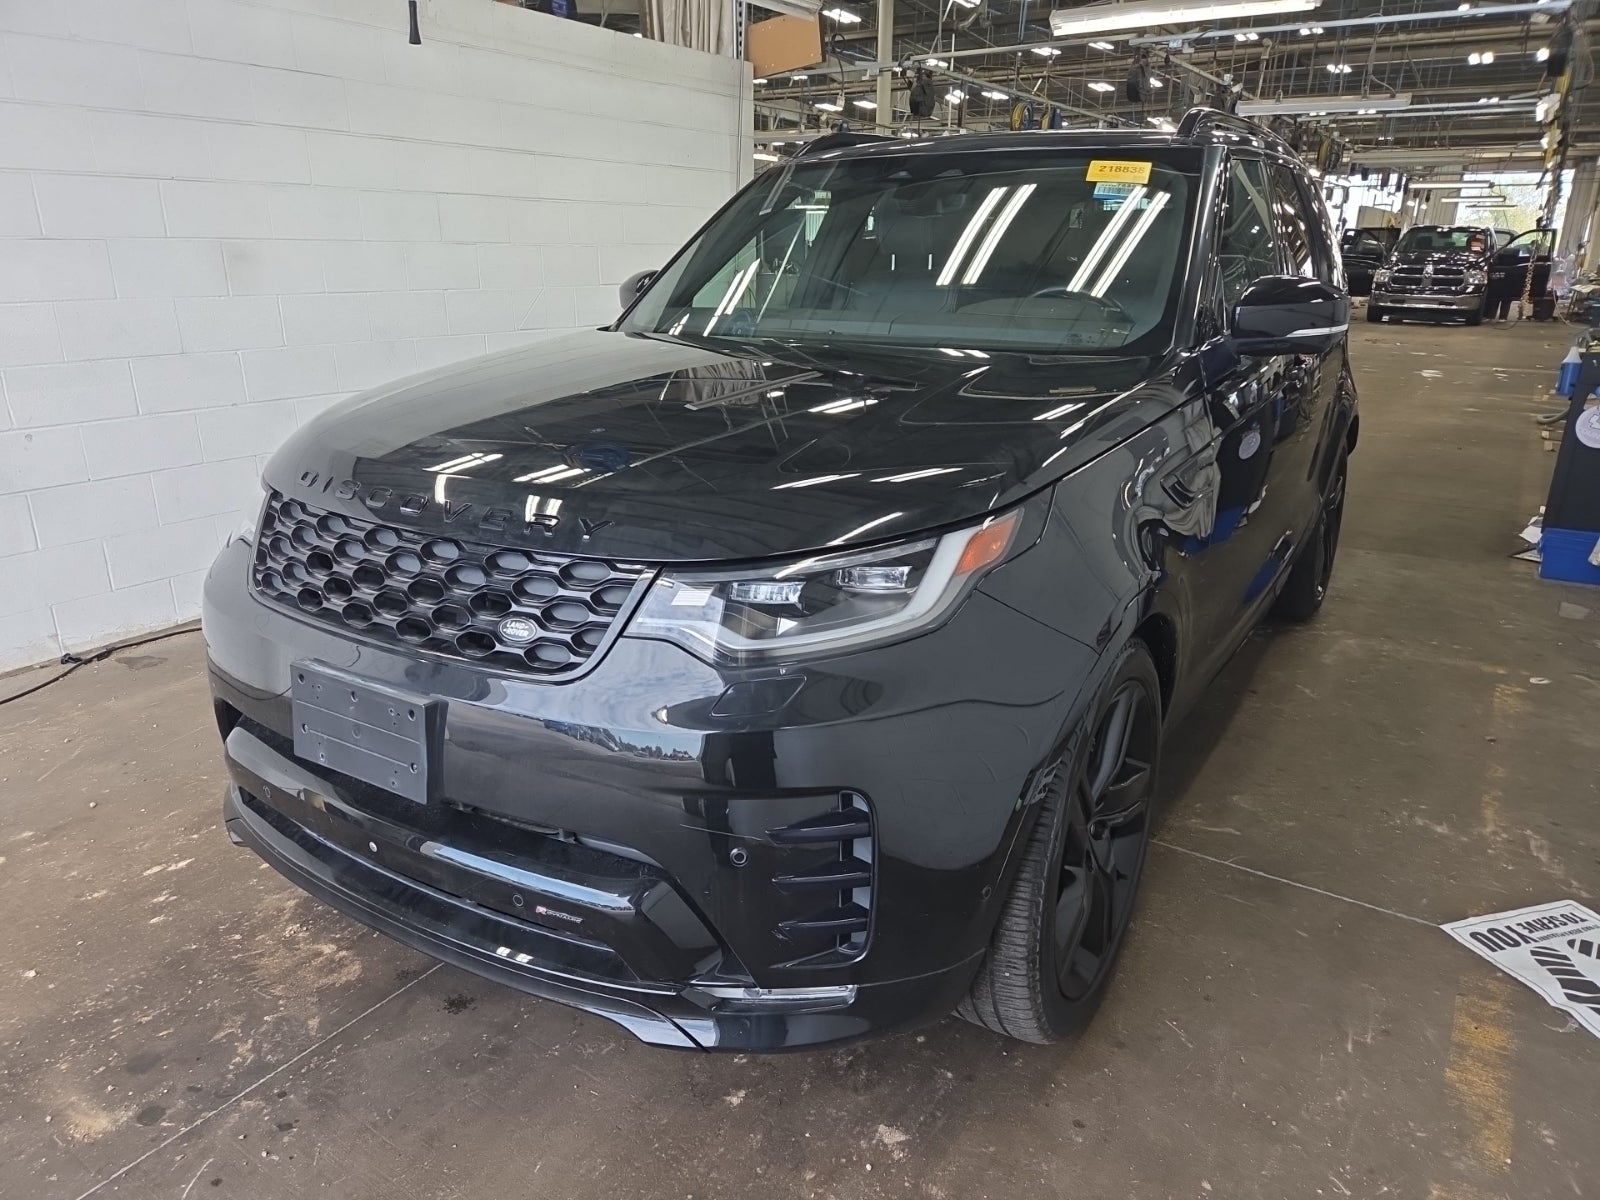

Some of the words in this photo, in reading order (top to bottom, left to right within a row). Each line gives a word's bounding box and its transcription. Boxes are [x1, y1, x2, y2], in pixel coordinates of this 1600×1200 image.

[300, 471, 615, 541] DISCOVERY
[505, 627, 529, 637] ROVER
[506, 620, 526, 629] LAND
[1517, 915, 1569, 934] SERVE
[1560, 912, 1589, 924] TO
[1469, 925, 1540, 953] YOU
